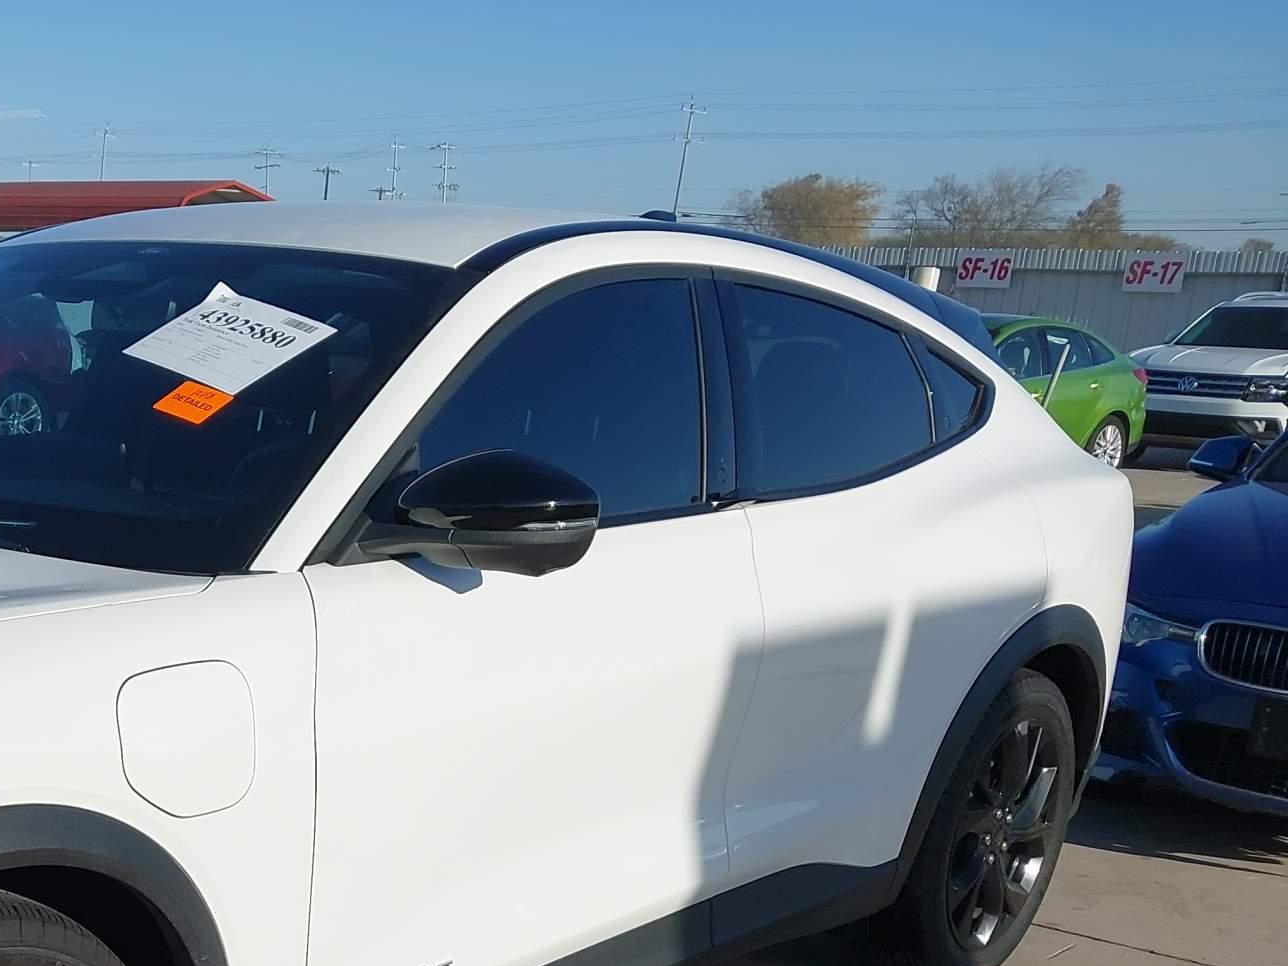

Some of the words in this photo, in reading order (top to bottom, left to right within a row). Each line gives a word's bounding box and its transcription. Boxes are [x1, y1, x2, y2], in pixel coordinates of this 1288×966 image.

[958, 257, 1012, 281] SF-16
[1124, 260, 1184, 285] SF-17
[198, 308, 297, 349] 43925880
[172, 393, 214, 411] DETAILED
